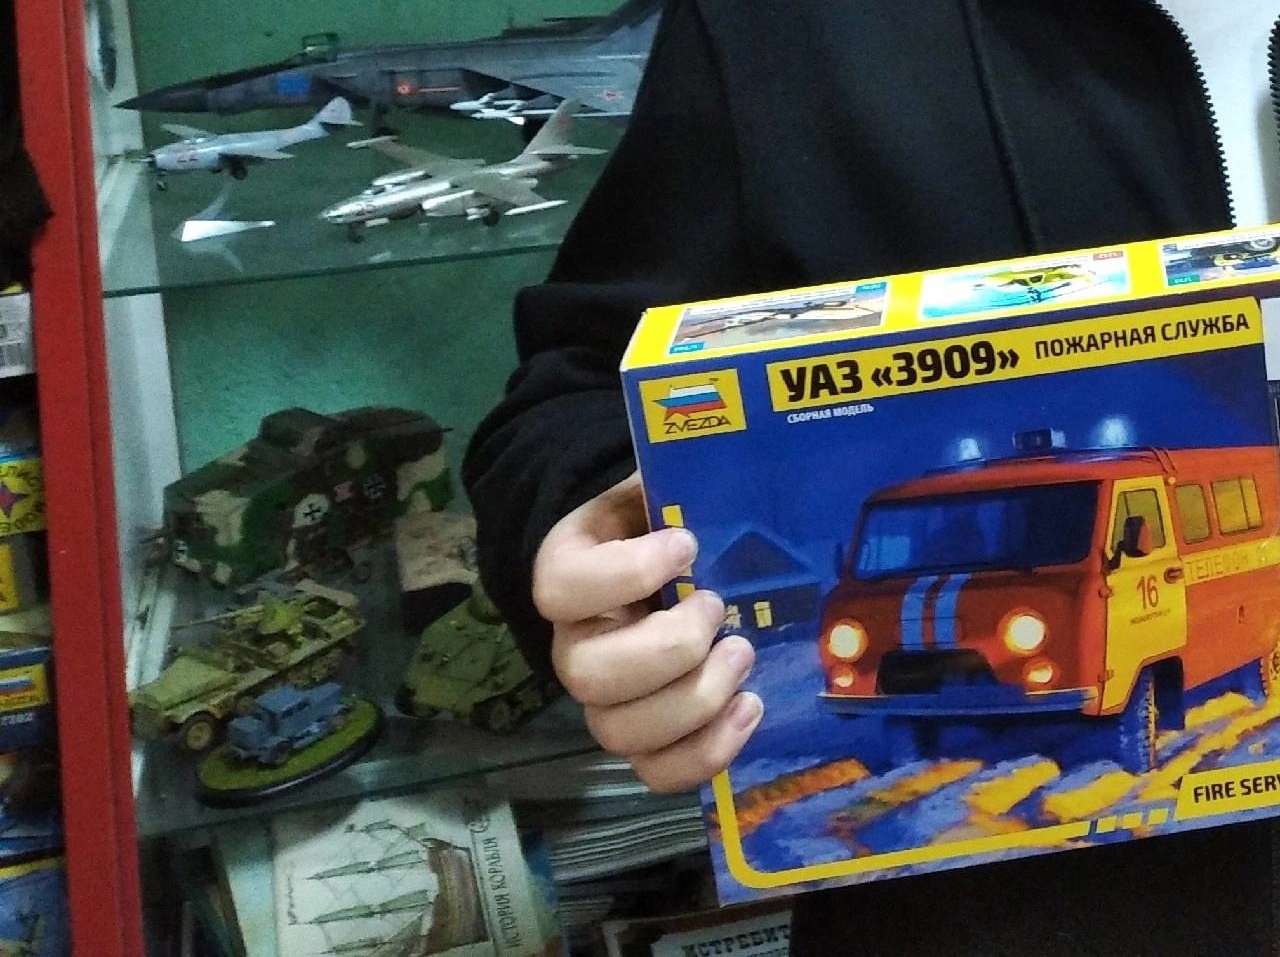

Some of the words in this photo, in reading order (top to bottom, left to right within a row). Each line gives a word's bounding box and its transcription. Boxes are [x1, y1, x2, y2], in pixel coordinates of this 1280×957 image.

[1035, 326, 1157, 360] ПОЖАРНАЯ
[1160, 311, 1250, 346] СЛУЖБА
[780, 358, 862, 403] УАЗ
[872, 340, 1020, 391] «3909»
[664, 414, 732, 435] ZVEZDA
[786, 407, 832, 425] СБОРНАЯ
[833, 402, 875, 420] МОДЕЛЬ
[1136, 573, 1159, 611] 16
[1193, 780, 1236, 804] FIRE
